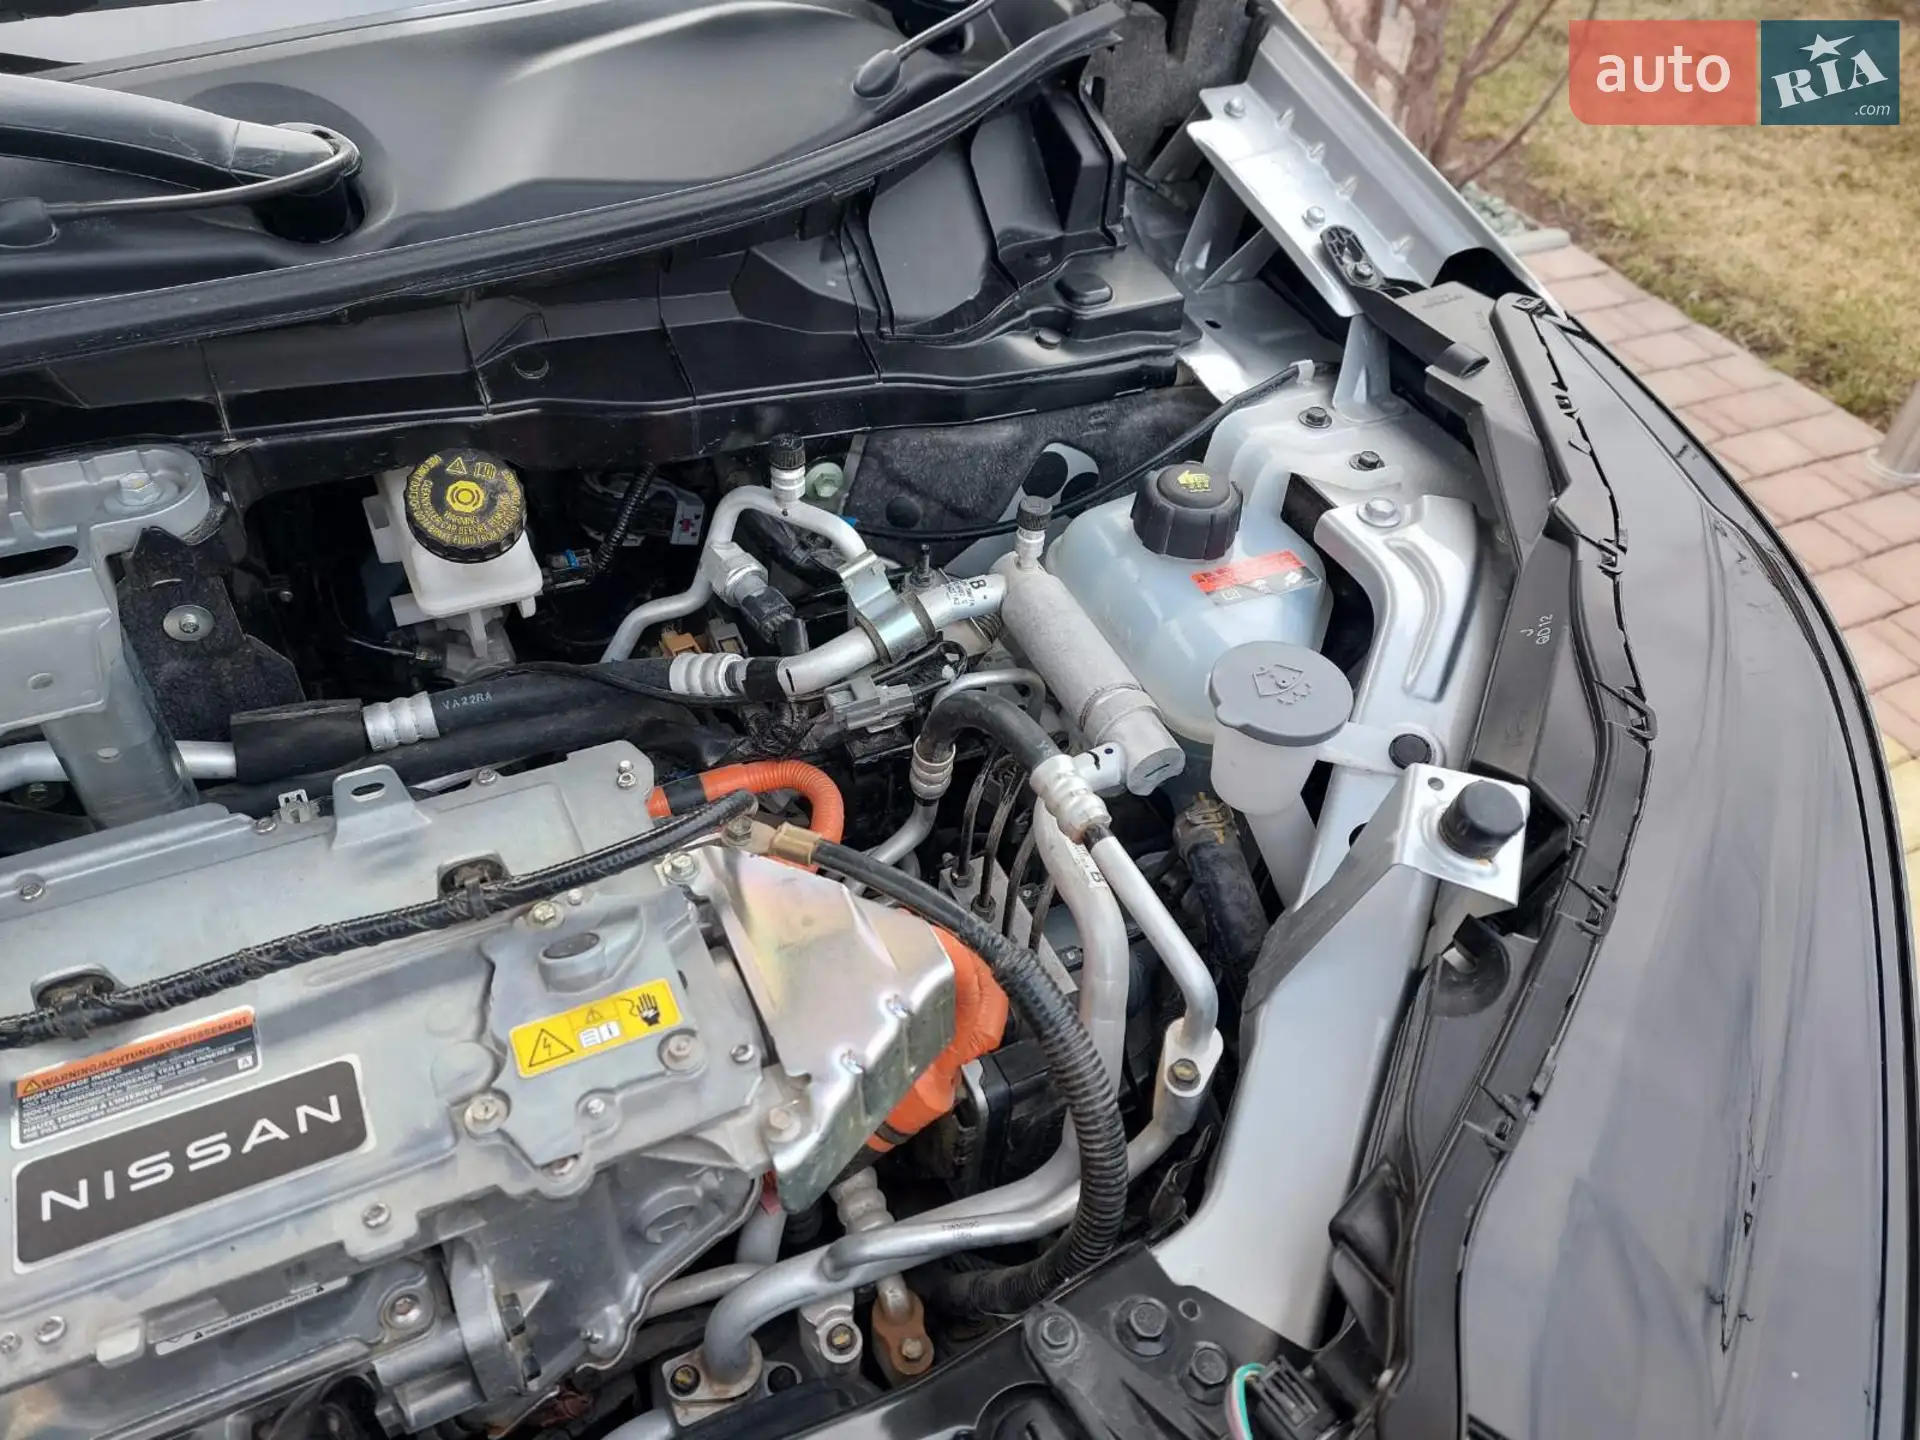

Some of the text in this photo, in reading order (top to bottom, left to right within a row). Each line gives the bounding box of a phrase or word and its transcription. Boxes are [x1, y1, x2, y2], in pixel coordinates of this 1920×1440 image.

[440, 520, 457, 533] CAP
[459, 522, 489, 535] BEFORE
[22, 1066, 121, 1103] HIGH VOLTAGE INSIDE
[41, 1094, 342, 1222] NISSAN
